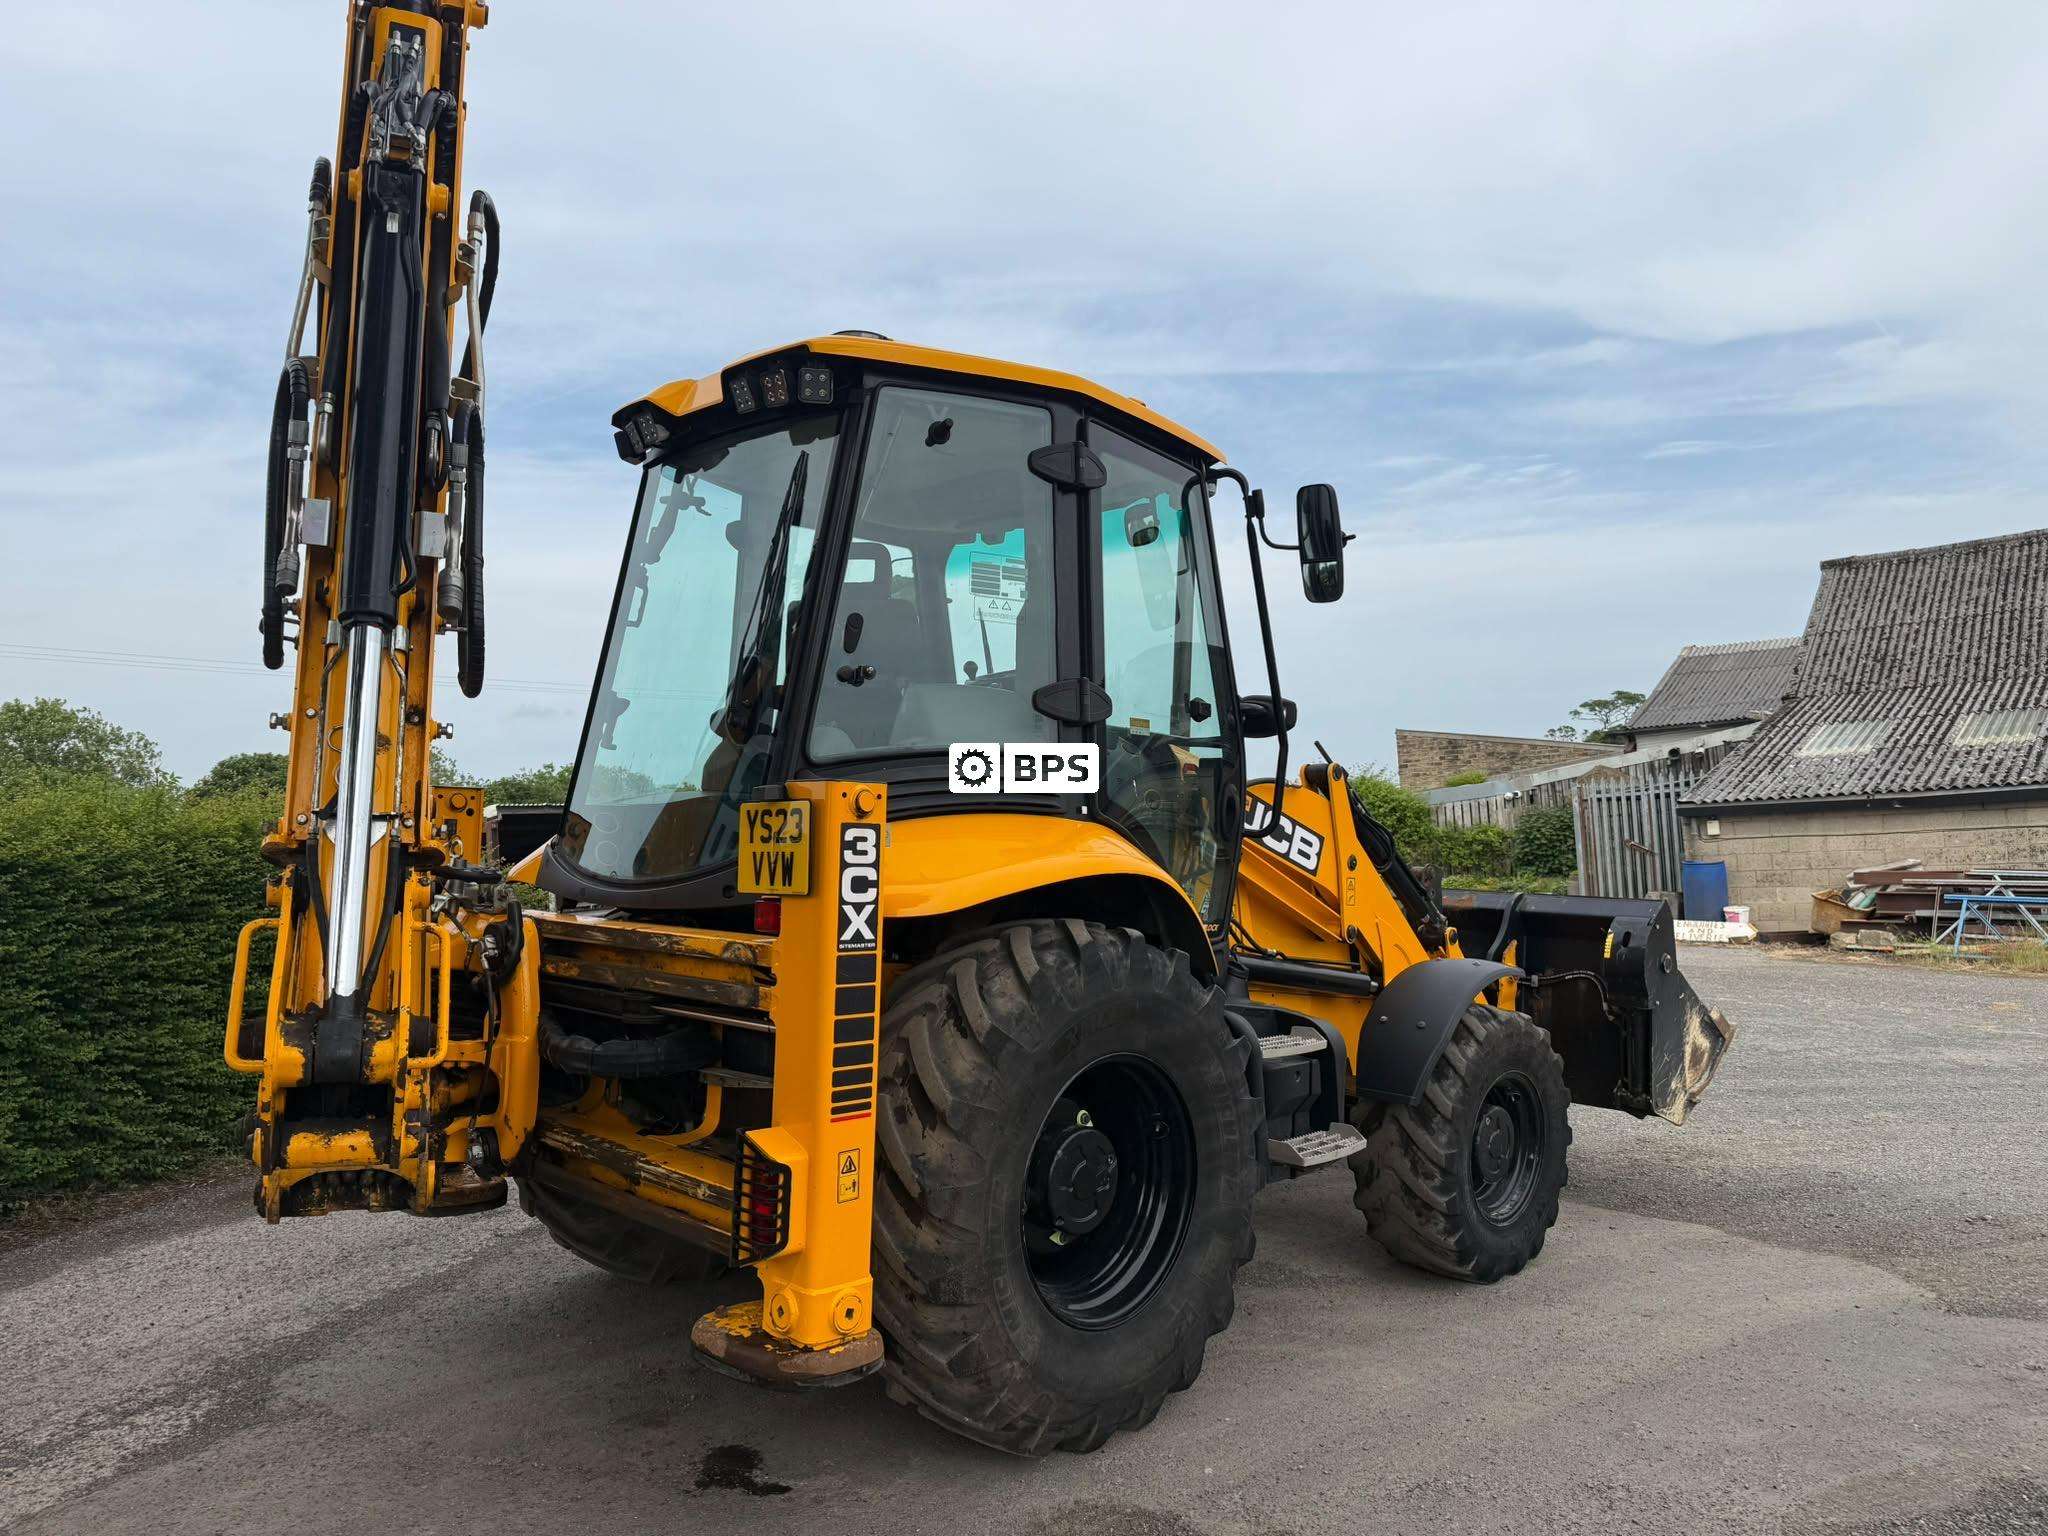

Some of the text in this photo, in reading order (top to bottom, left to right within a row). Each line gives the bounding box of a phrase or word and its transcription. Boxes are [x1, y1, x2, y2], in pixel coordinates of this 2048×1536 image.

[746, 808, 803, 844] YS23
[1244, 801, 1321, 871] JCB
[752, 851, 794, 887] VVW
[840, 827, 878, 941] 3CX
